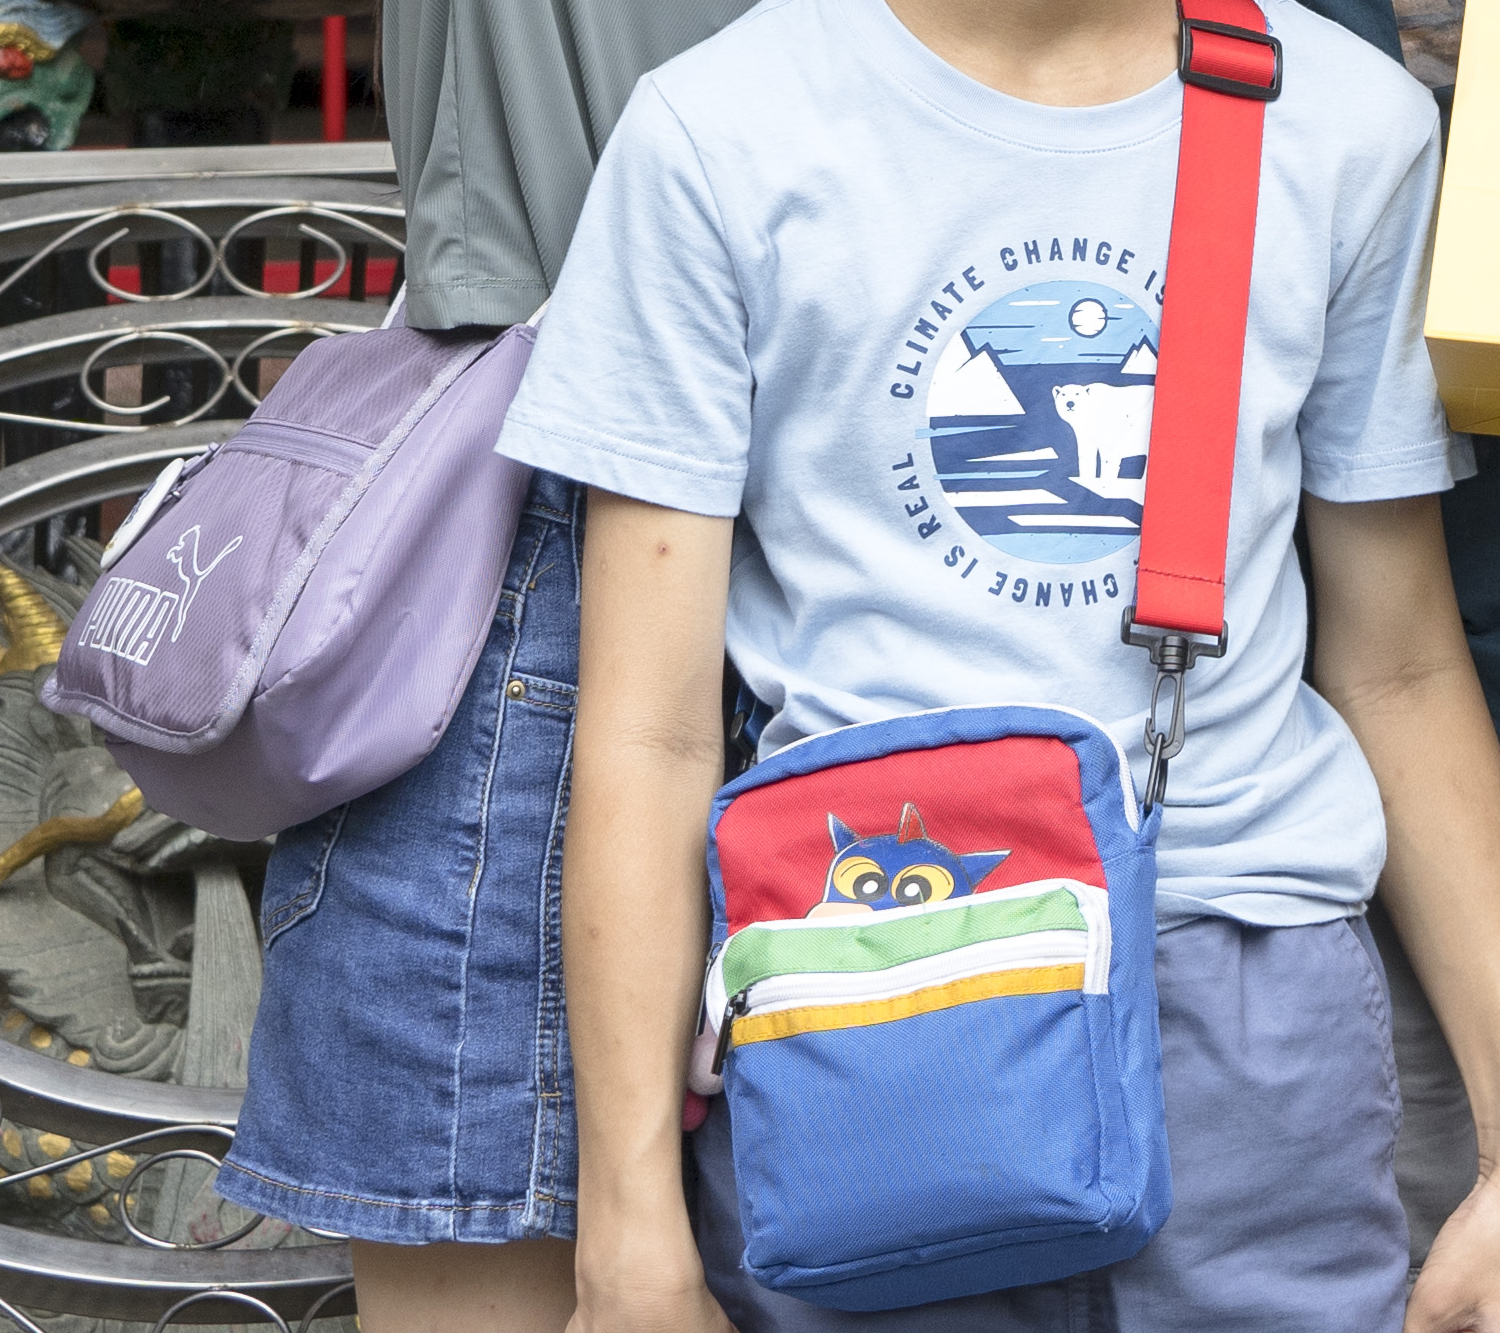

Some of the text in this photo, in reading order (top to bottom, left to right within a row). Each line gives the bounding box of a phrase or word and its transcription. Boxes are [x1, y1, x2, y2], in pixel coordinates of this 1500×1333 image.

[889, 264, 986, 401] CLIMATE
[999, 236, 1137, 276] CHANGE
[889, 451, 1122, 609] CHANGE IS REAL
[77, 575, 181, 667] PUMA
